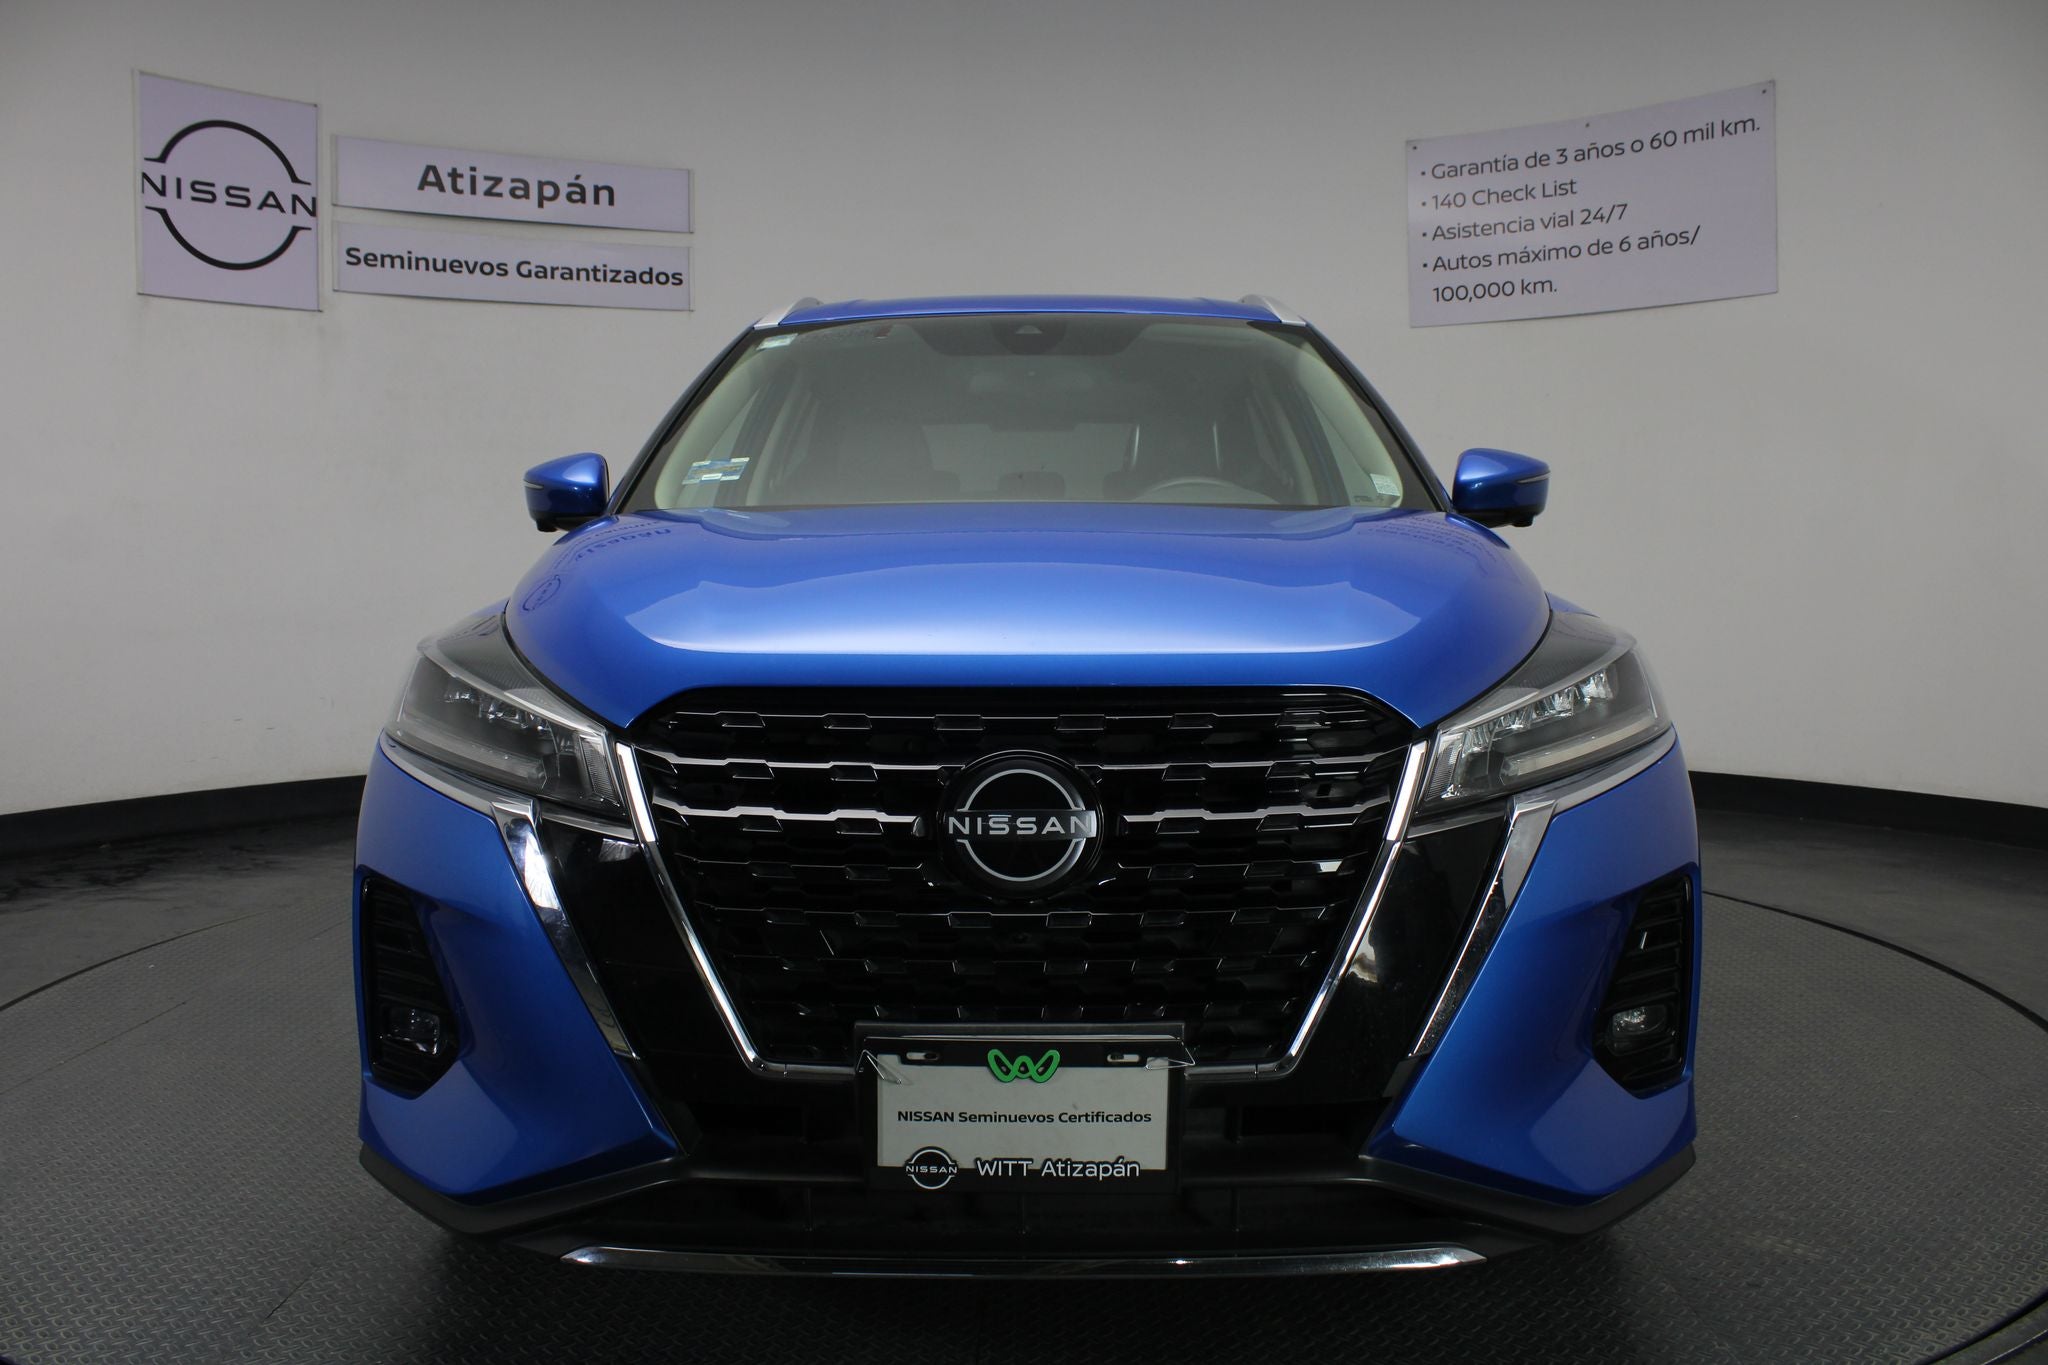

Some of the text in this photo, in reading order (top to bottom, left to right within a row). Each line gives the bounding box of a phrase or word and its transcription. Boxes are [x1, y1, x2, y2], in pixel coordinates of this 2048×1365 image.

[1432, 117, 1760, 179] Garantía de 3 años o 60 mil km.
[141, 171, 317, 217] NISSAN
[418, 164, 615, 208] Atizapán
[1432, 178, 1577, 210] 140 Check List
[1432, 204, 1628, 241] Asistencia vial 24/7
[1432, 225, 1700, 272] Autos máximo de 6 años/
[345, 247, 684, 286] Seminuevos Garantizados
[1433, 278, 1557, 303] 100,000 km.
[949, 816, 1093, 835] NISSAN
[897, 1111, 1151, 1123] NISSAN Seminuevos Certificados
[906, 1165, 957, 1174] NISSAN
[976, 1158, 1140, 1181] WITT Atizapán
